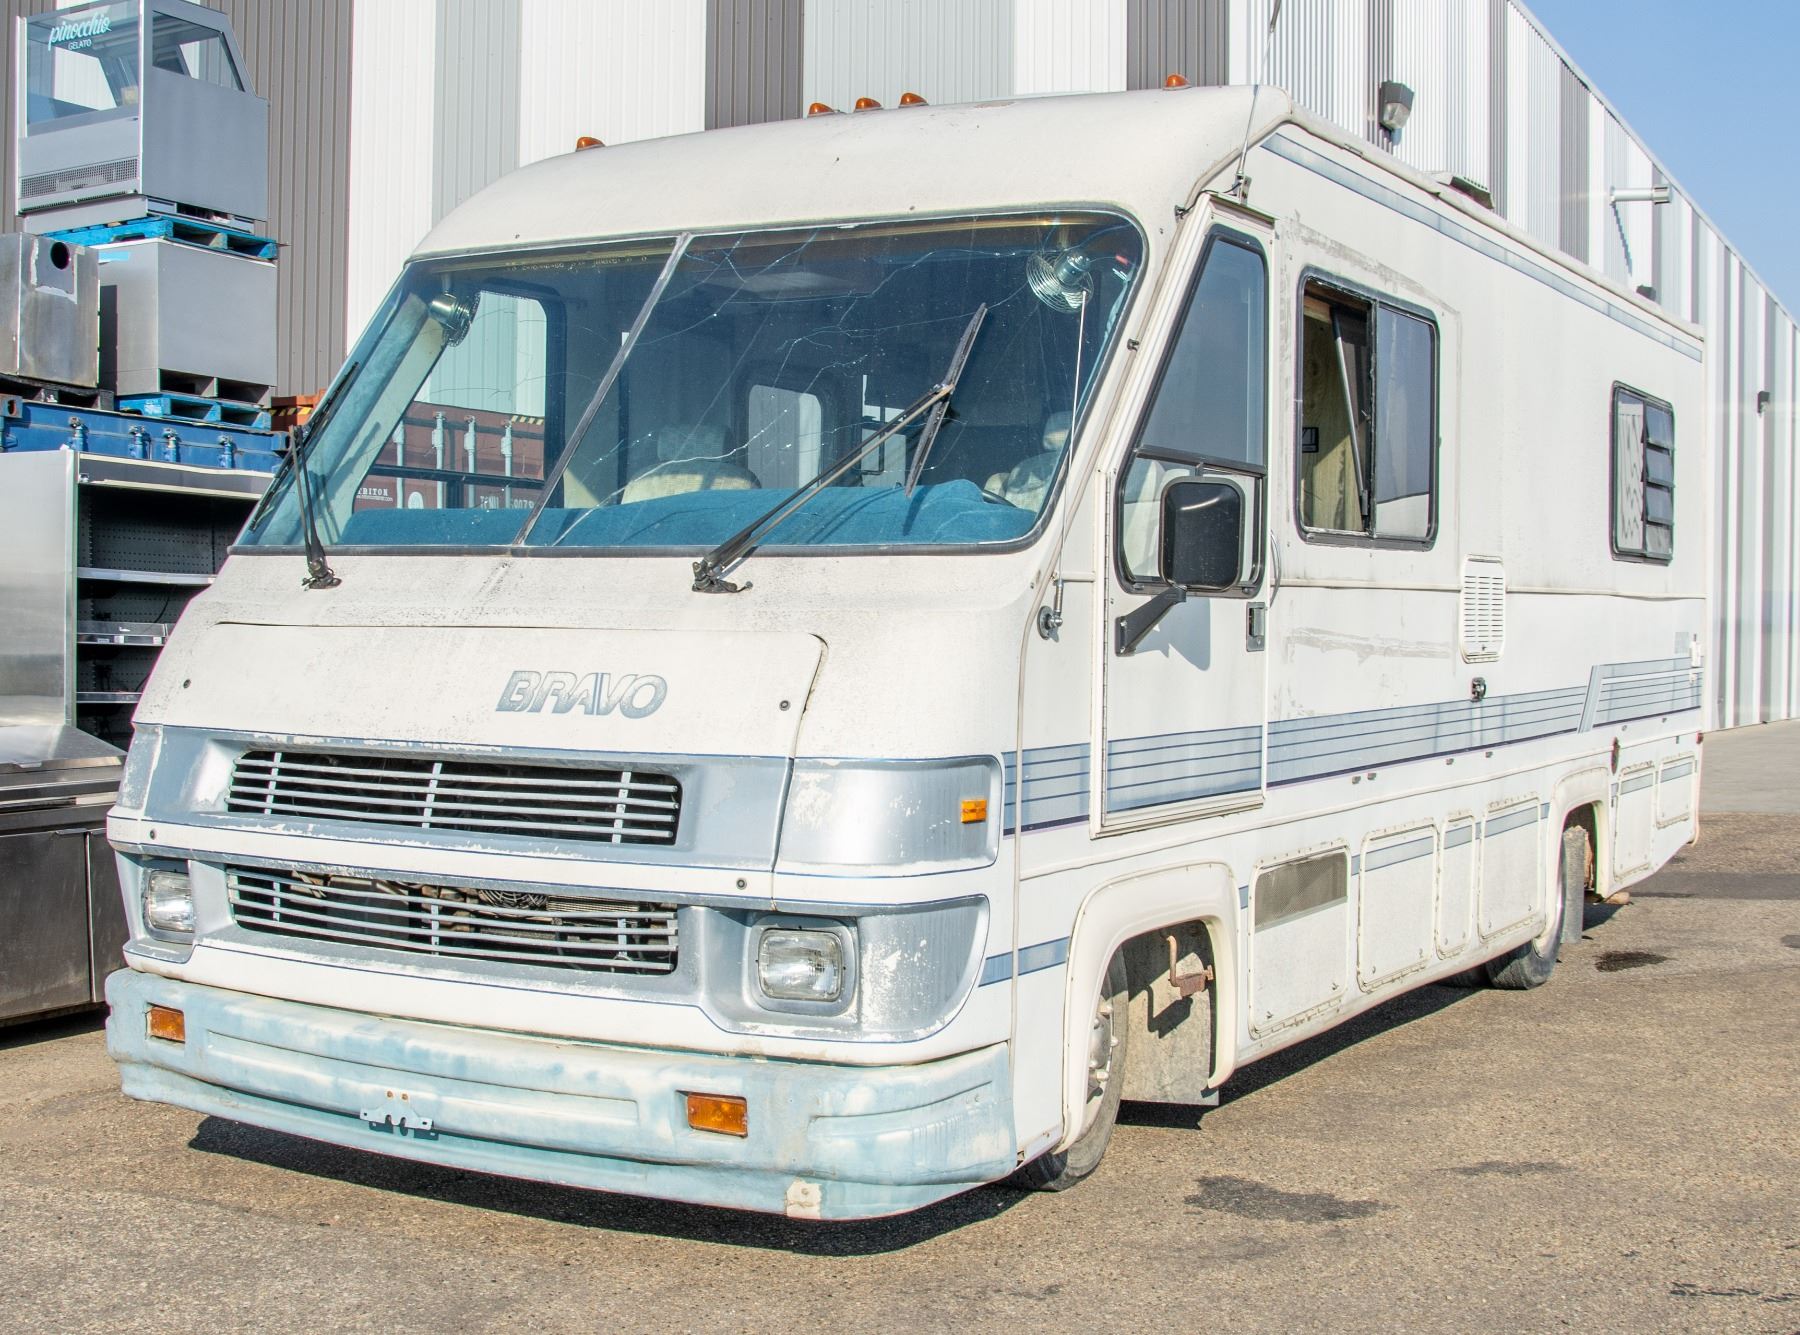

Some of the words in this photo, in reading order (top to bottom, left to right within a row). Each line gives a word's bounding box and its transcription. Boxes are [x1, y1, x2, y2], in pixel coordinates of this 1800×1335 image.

[47, 12, 112, 51] pinocchio
[68, 39, 92, 50] GELATO
[357, 487, 389, 496] TRITON
[495, 670, 668, 719] BRAVO
